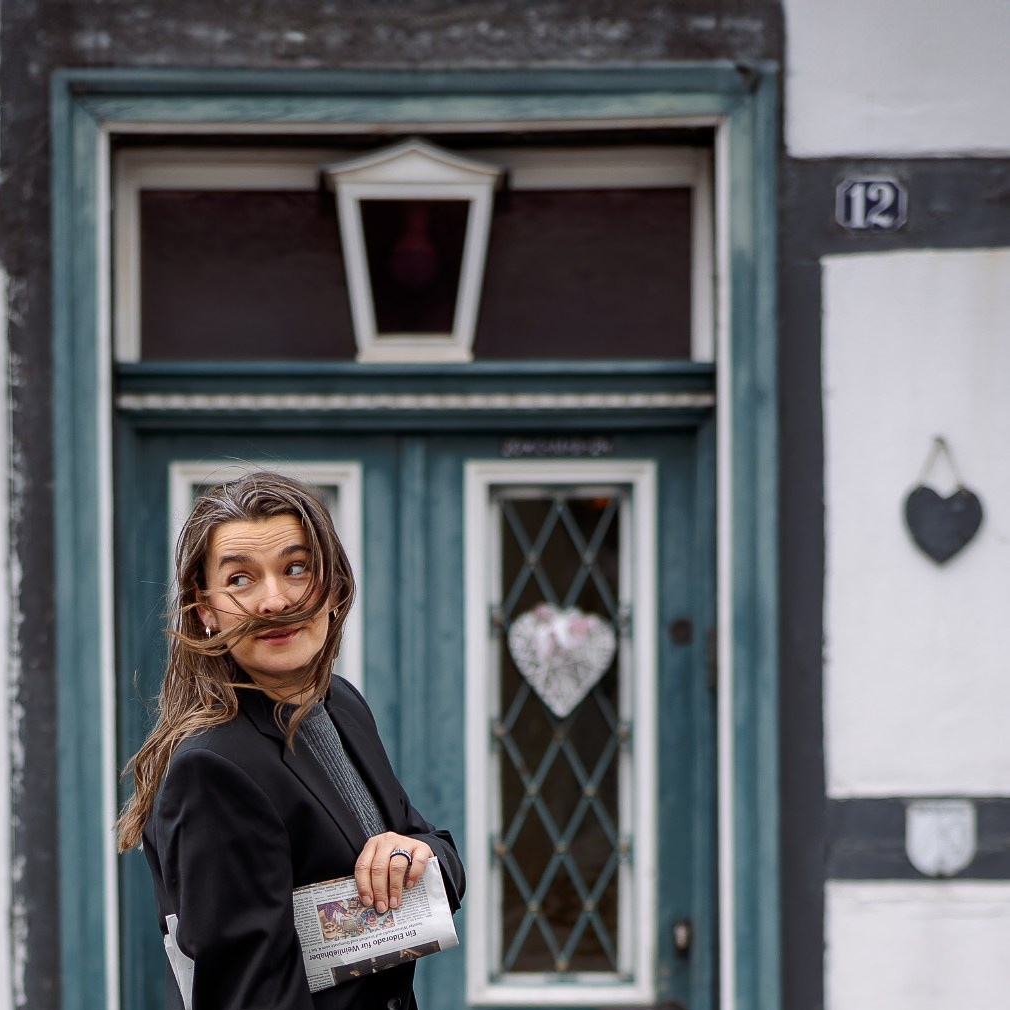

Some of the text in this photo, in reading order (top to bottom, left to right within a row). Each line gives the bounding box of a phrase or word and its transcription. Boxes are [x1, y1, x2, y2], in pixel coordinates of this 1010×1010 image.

[850, 182, 895, 229] 12
[309, 929, 417, 961] Ein Eldorado für Weinliebhaber
